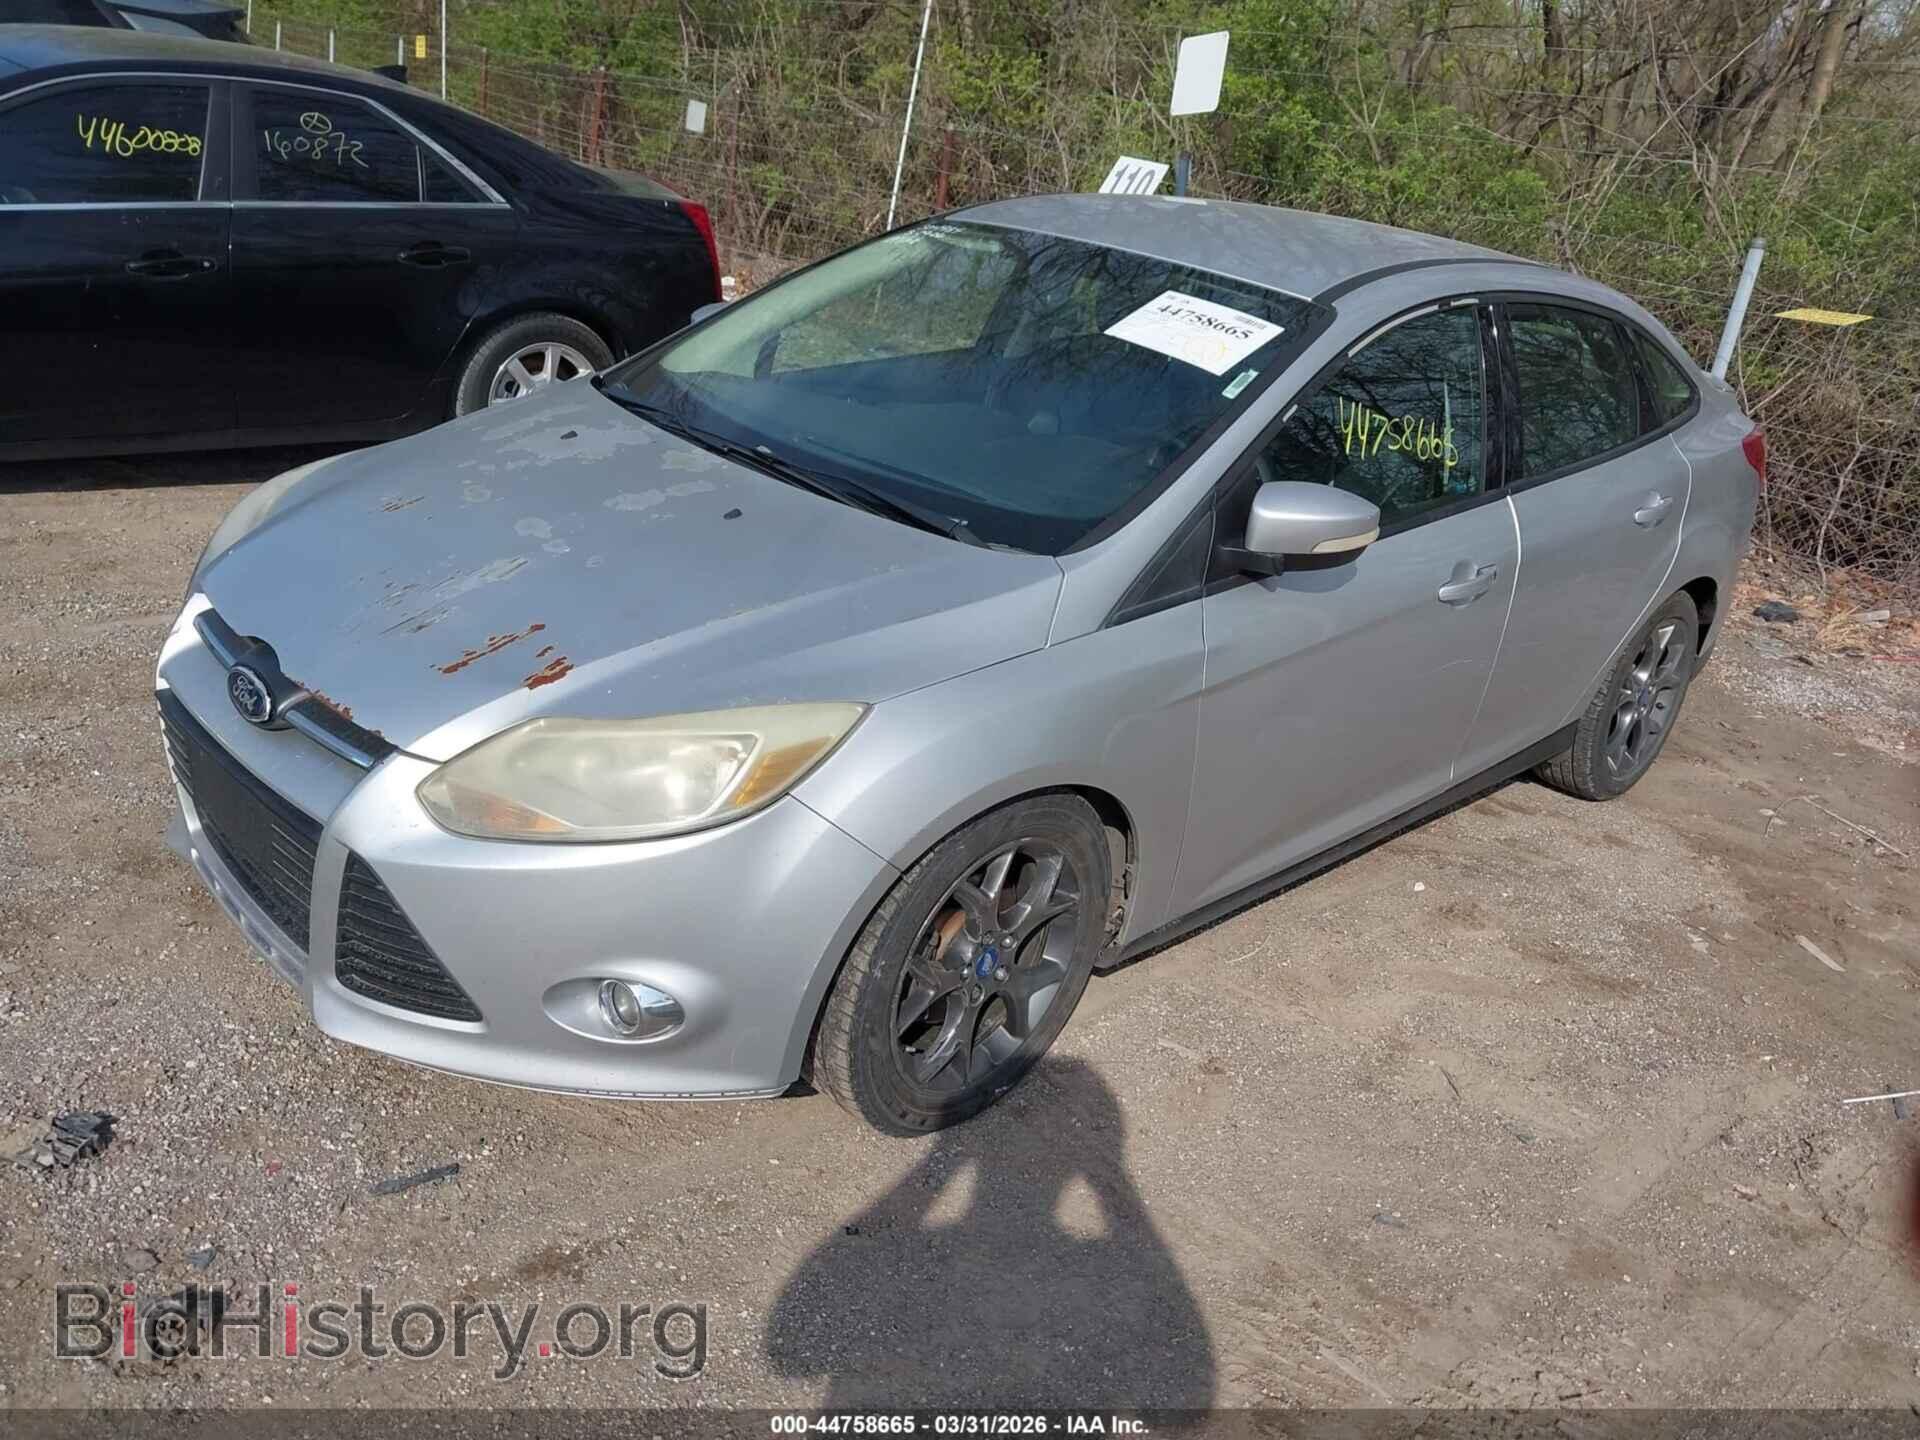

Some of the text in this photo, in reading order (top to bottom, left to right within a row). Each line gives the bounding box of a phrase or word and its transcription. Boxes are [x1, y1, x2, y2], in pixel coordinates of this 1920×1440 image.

[79, 114, 201, 156] 44600808
[265, 131, 368, 167] 160872
[1158, 305, 1254, 344] 44758665
[1340, 396, 1458, 466] 44758665
